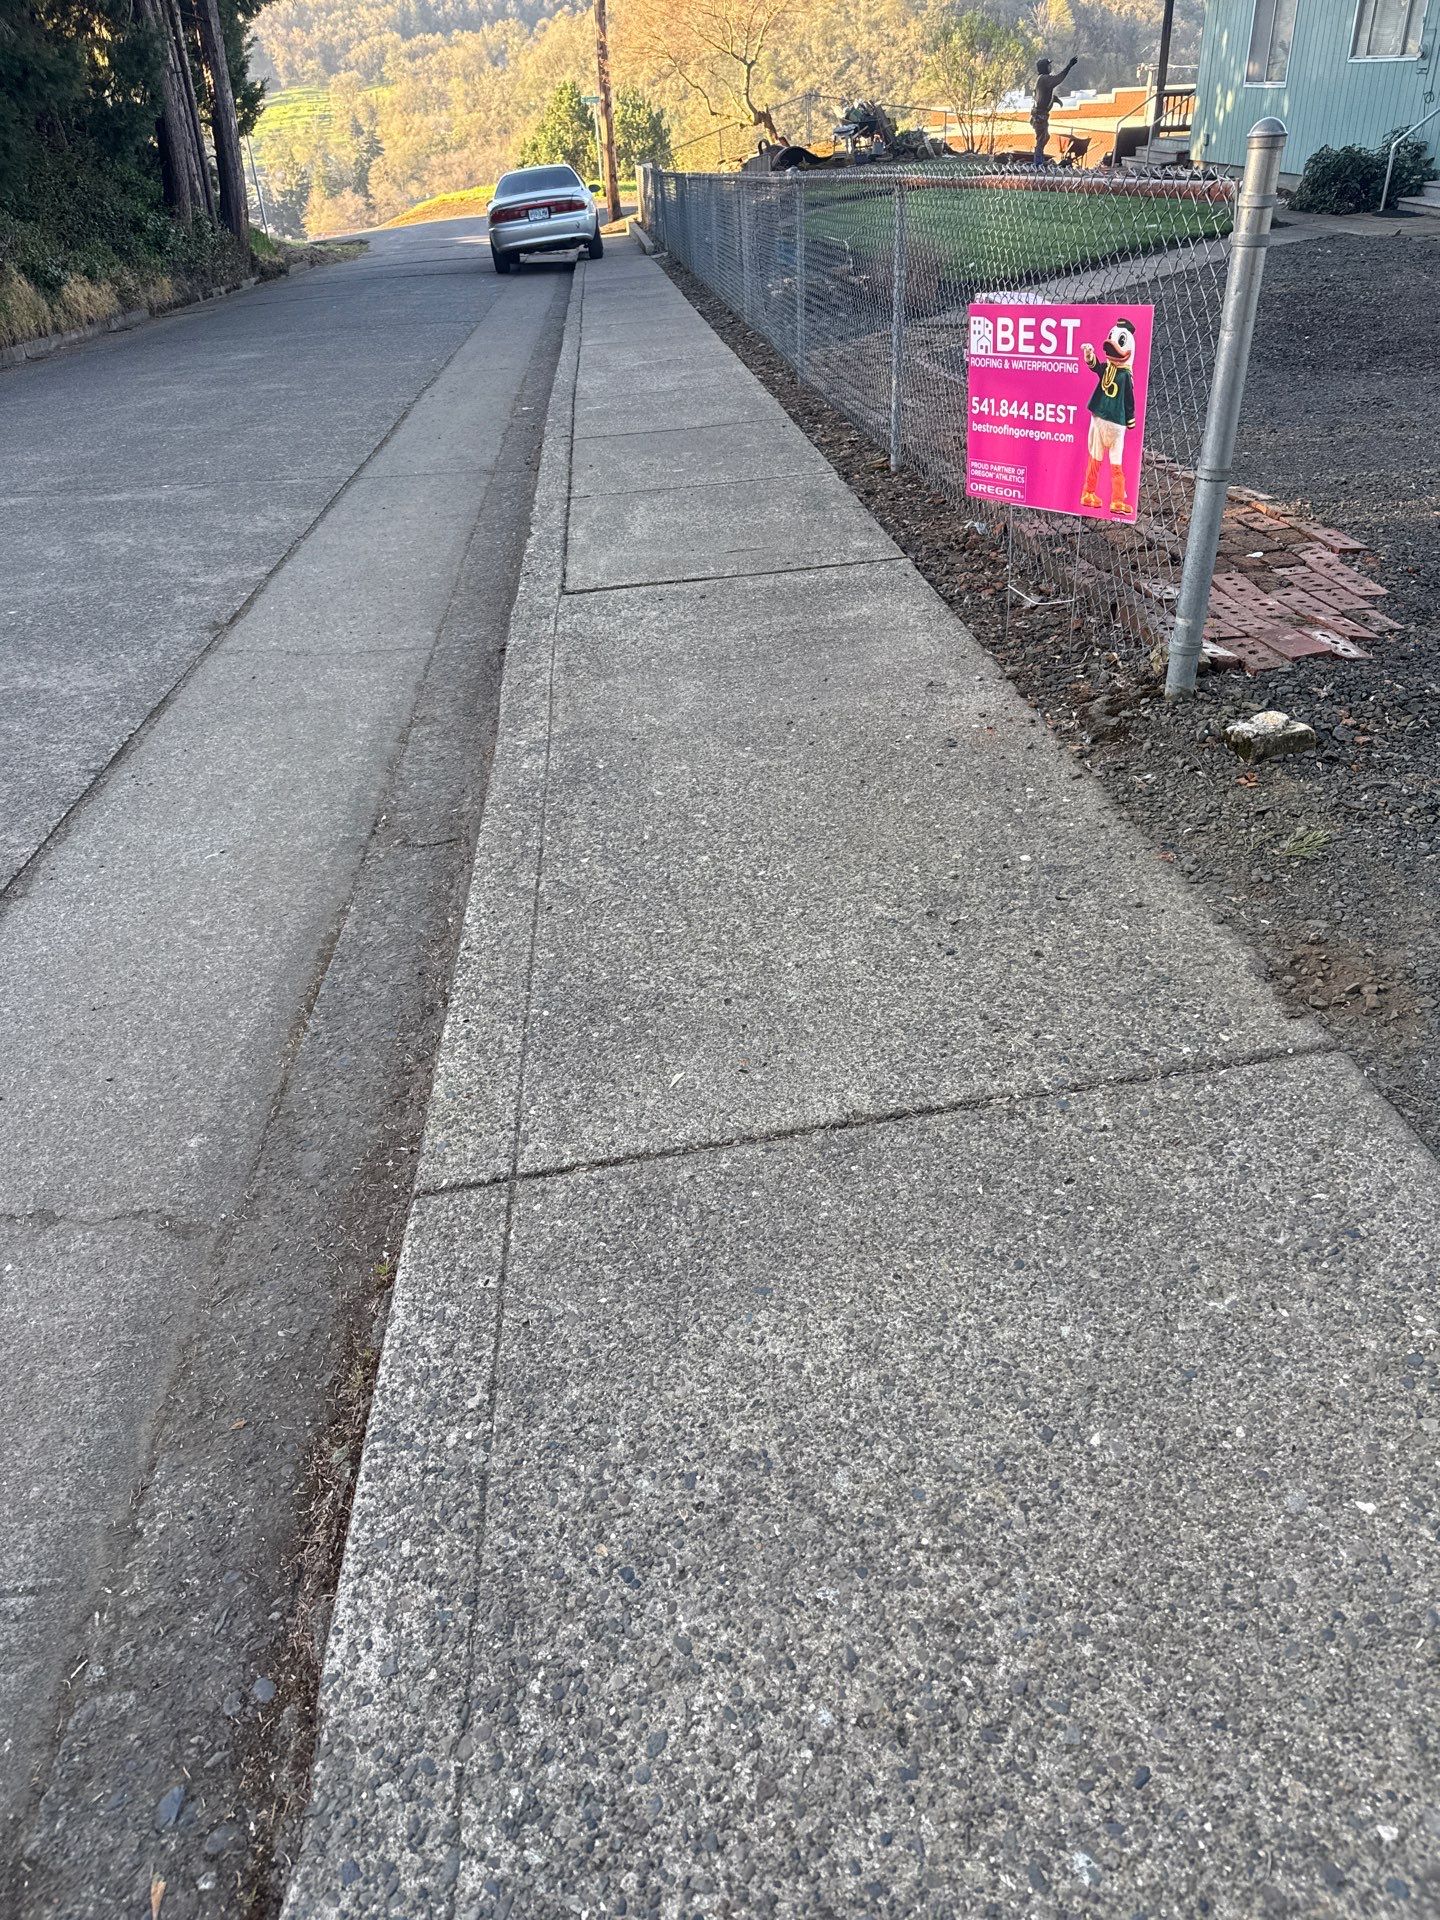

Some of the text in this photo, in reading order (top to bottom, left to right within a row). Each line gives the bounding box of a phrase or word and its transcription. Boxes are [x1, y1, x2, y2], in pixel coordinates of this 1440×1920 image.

[997, 317, 1081, 355] BEST
[970, 357, 1079, 374] ROOFING & WATERPROOFING
[971, 396, 1077, 425] 541.844.BEST
[972, 421, 1074, 443] bestroofingoregon.com
[970, 462, 989, 470] PROUD
[990, 465, 1015, 474] PARTNER
[996, 473, 1025, 484] ATHLETICS
